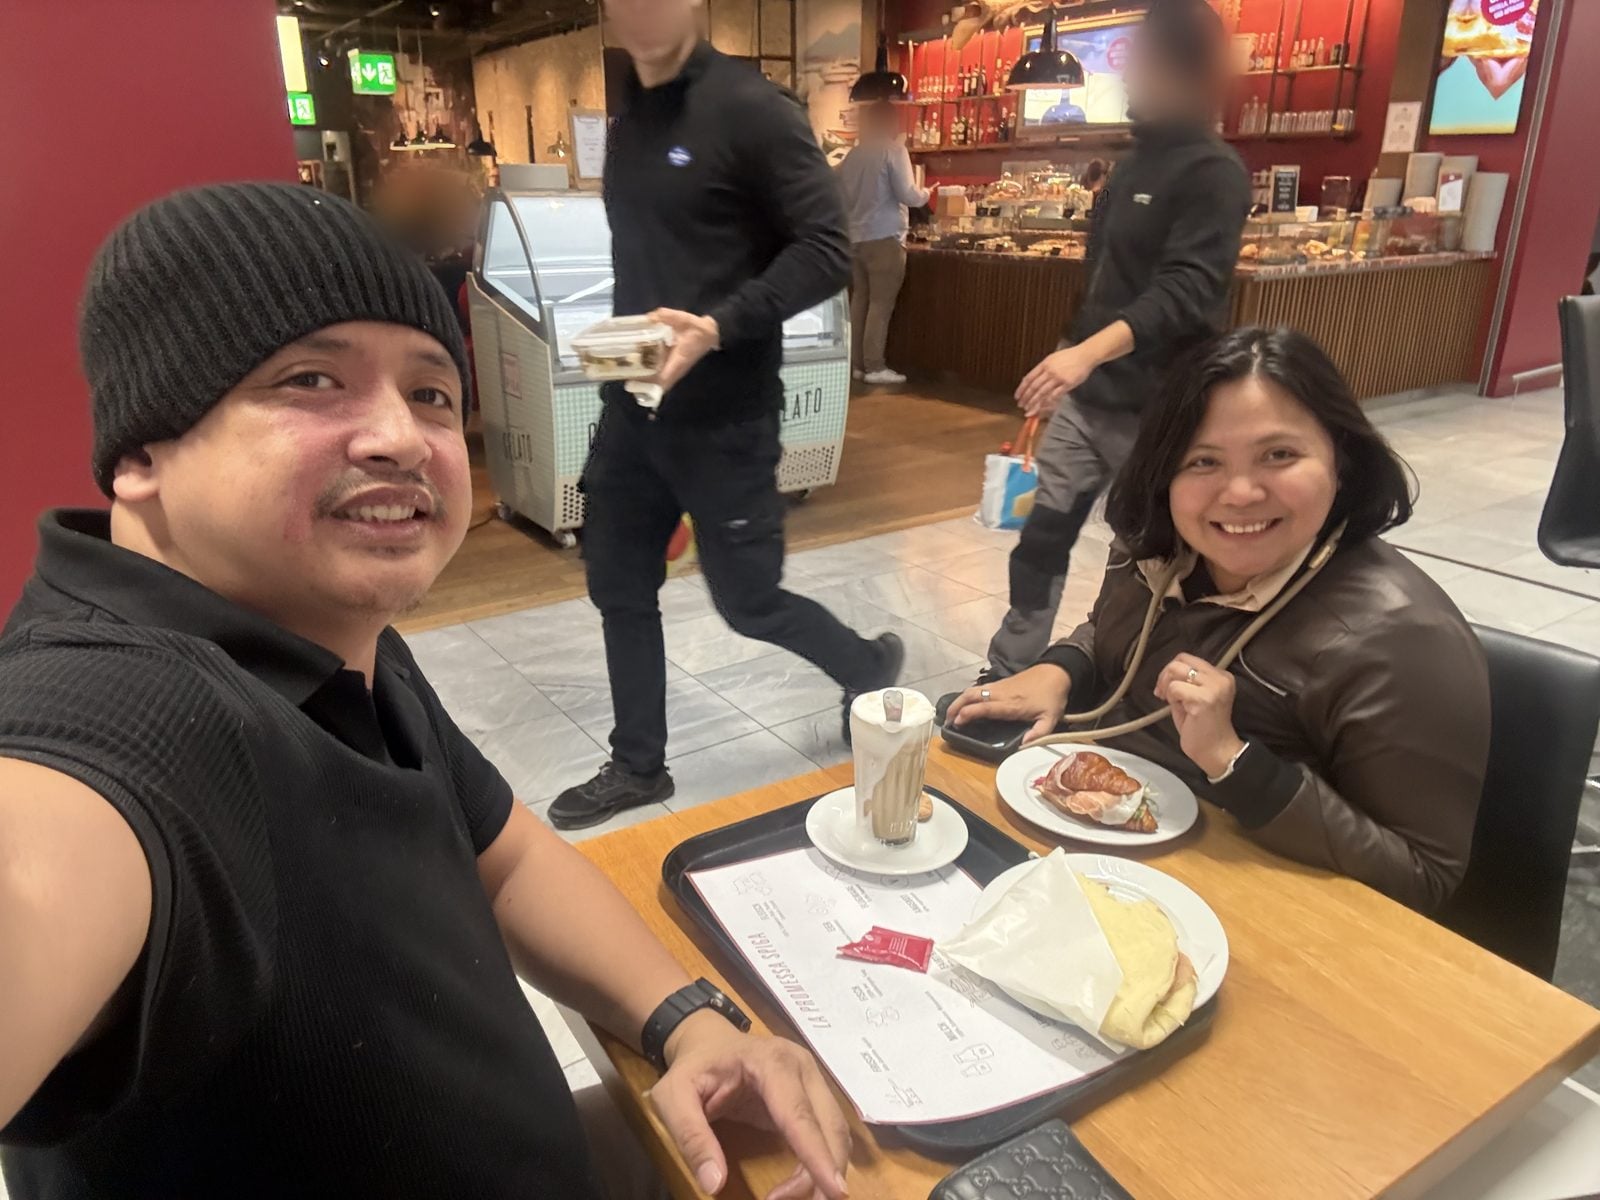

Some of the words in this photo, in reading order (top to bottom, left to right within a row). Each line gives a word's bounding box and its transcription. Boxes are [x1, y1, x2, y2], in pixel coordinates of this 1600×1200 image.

[782, 388, 822, 422] LATO
[502, 431, 533, 463] GELATO
[745, 932, 781, 960] SPIGA
[766, 960, 821, 1015] PROMESSA
[806, 1014, 833, 1031] LA
